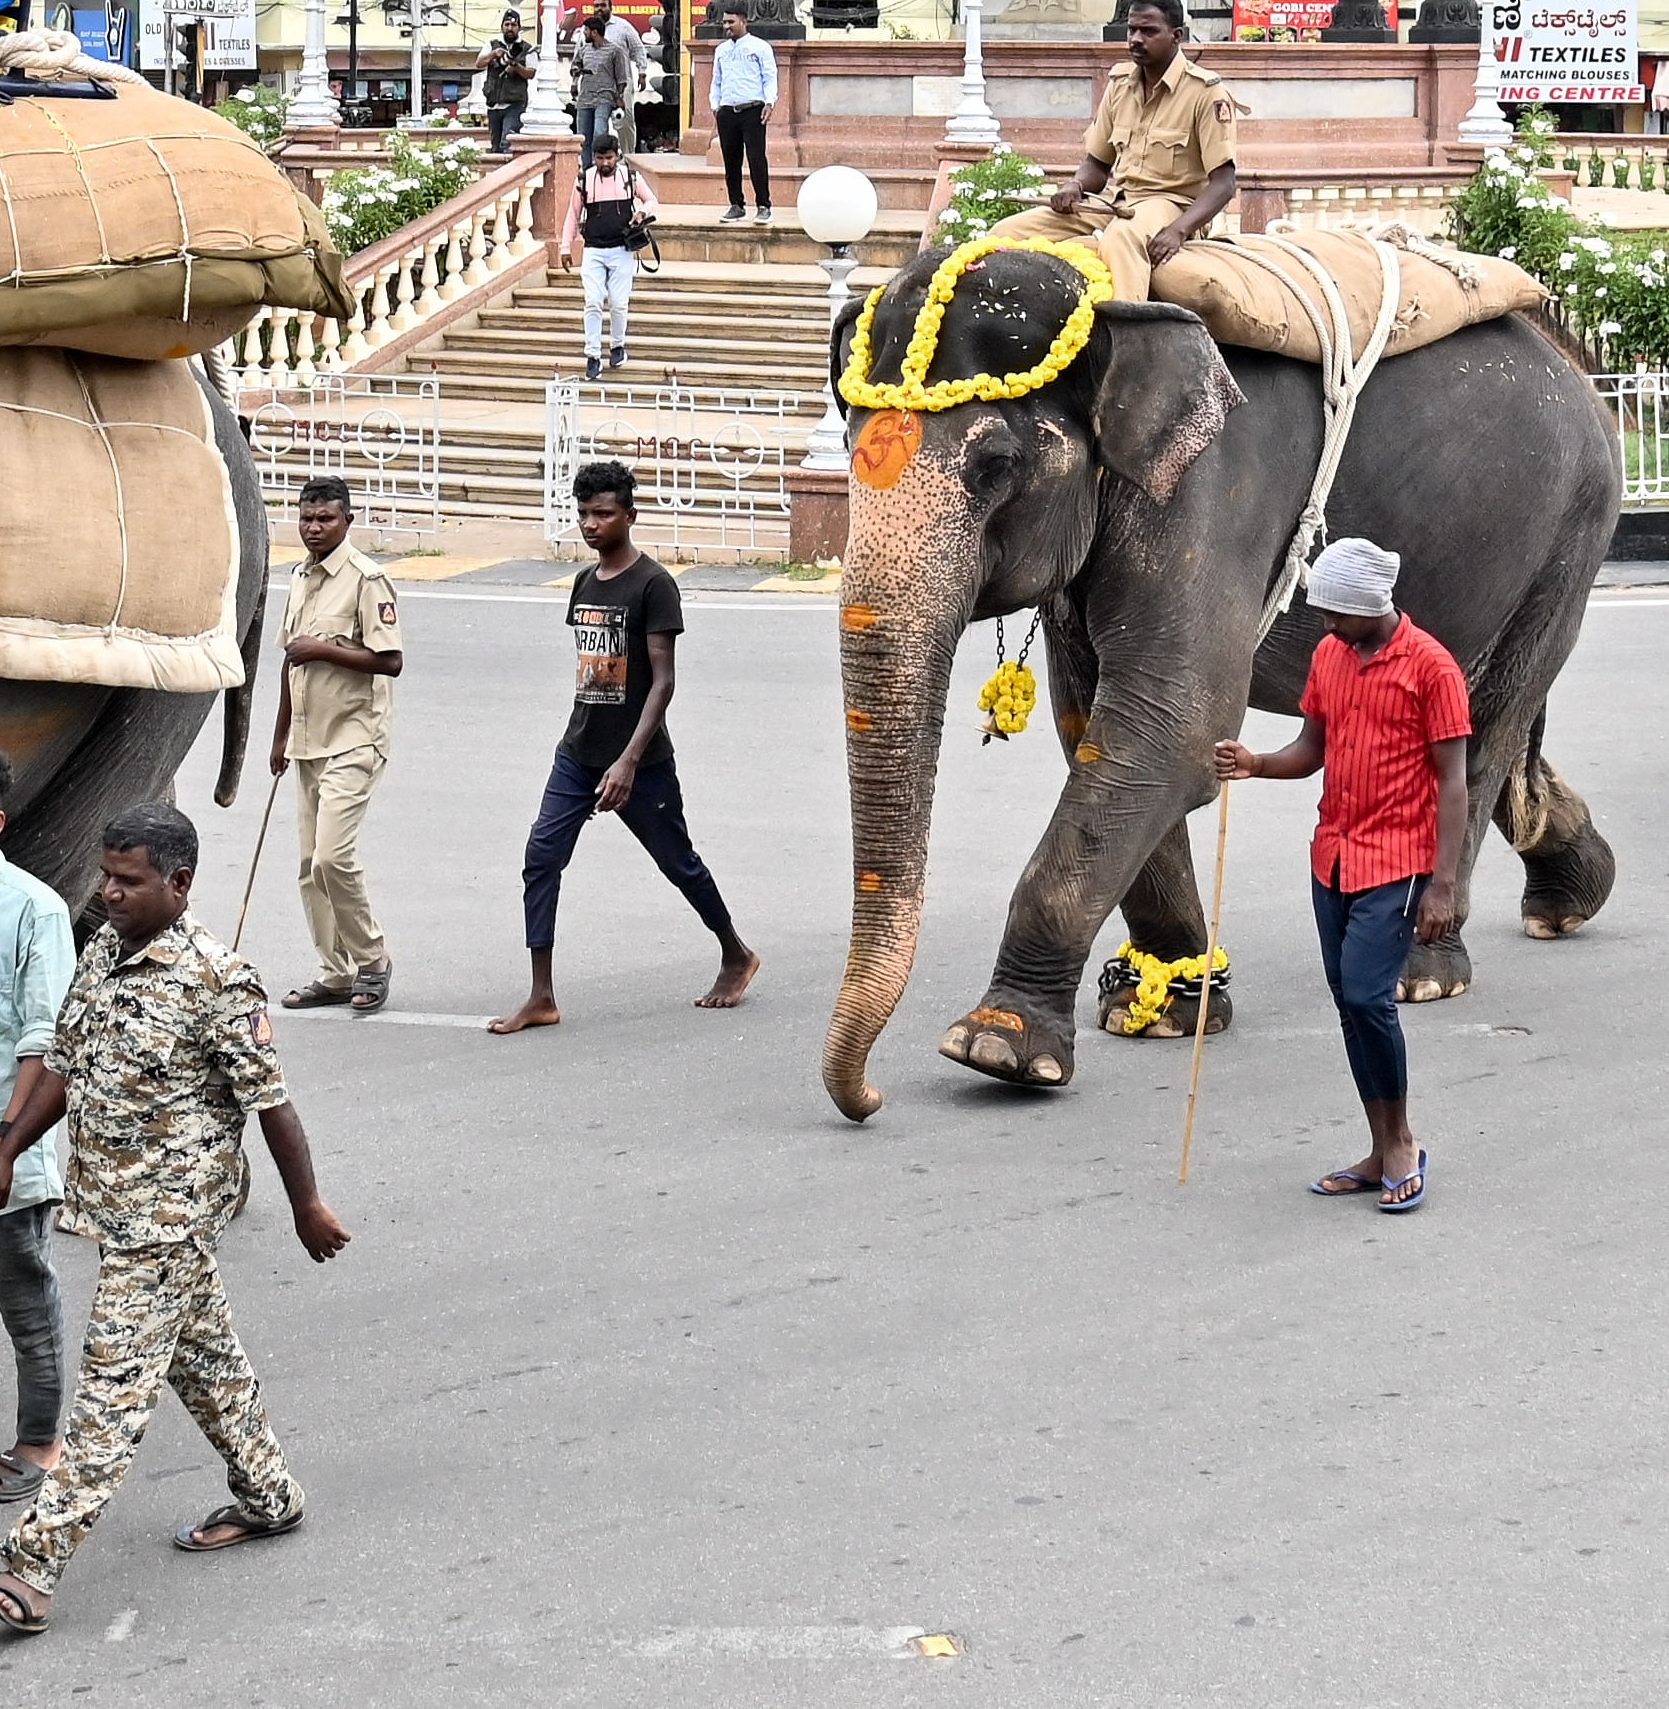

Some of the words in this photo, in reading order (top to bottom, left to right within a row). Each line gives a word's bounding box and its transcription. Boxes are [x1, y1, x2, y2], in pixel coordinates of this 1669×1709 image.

[1273, 2, 1304, 13] GOBI
[145, 23, 162, 35] OLD
[219, 38, 251, 51] TEXTILES
[1529, 47, 1626, 63] TEXTILES
[1500, 70, 1567, 80] MATCHING
[1571, 70, 1630, 81] BLOUSES
[1549, 87, 1641, 100] CENTRE
